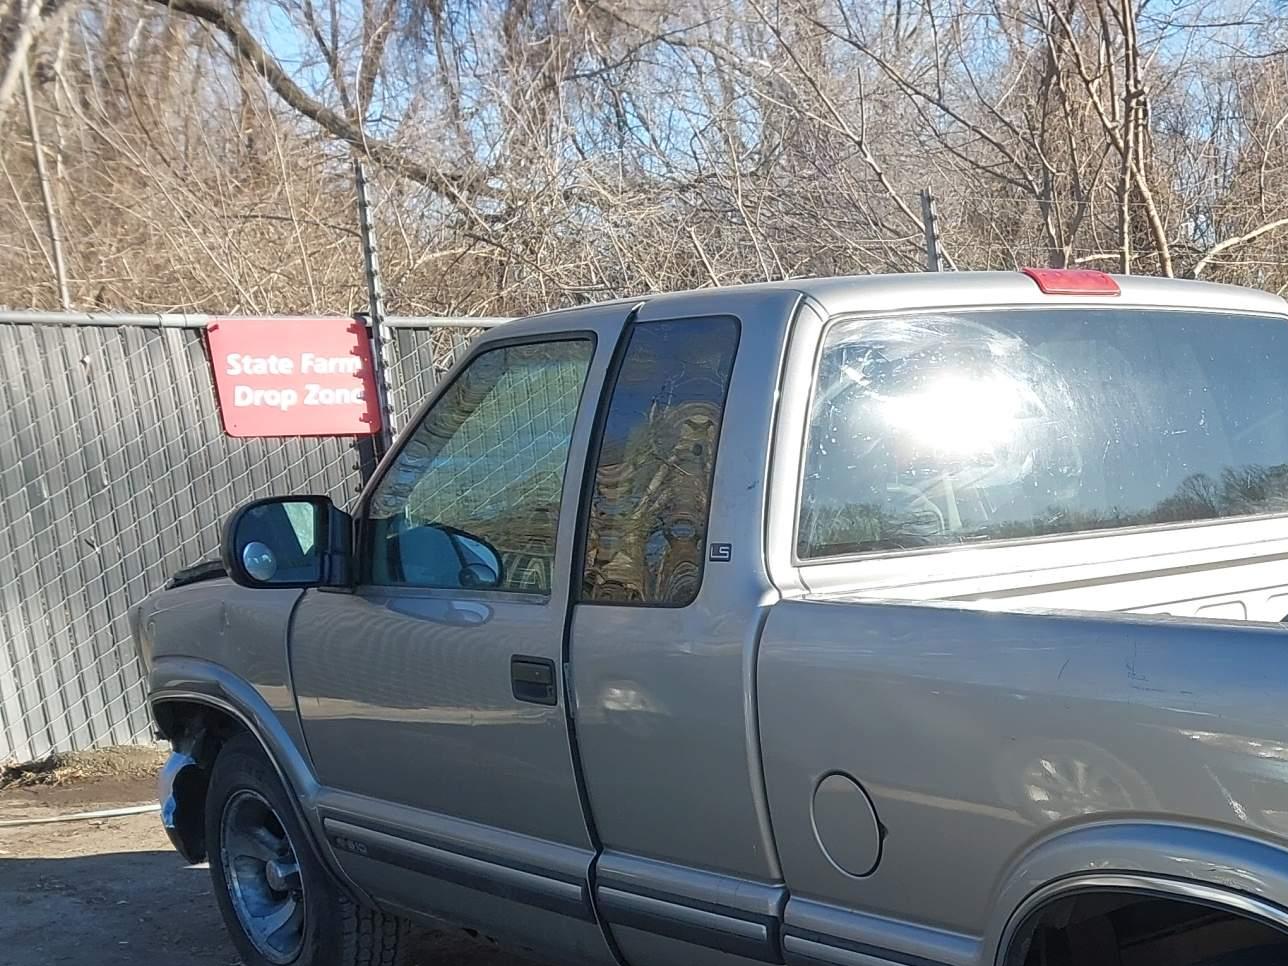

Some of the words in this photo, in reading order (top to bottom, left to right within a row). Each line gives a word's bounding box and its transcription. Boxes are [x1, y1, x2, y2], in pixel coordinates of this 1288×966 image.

[225, 353, 294, 376] State
[301, 352, 363, 375] Farm
[234, 385, 299, 411] Drop
[710, 545, 730, 559] LS
